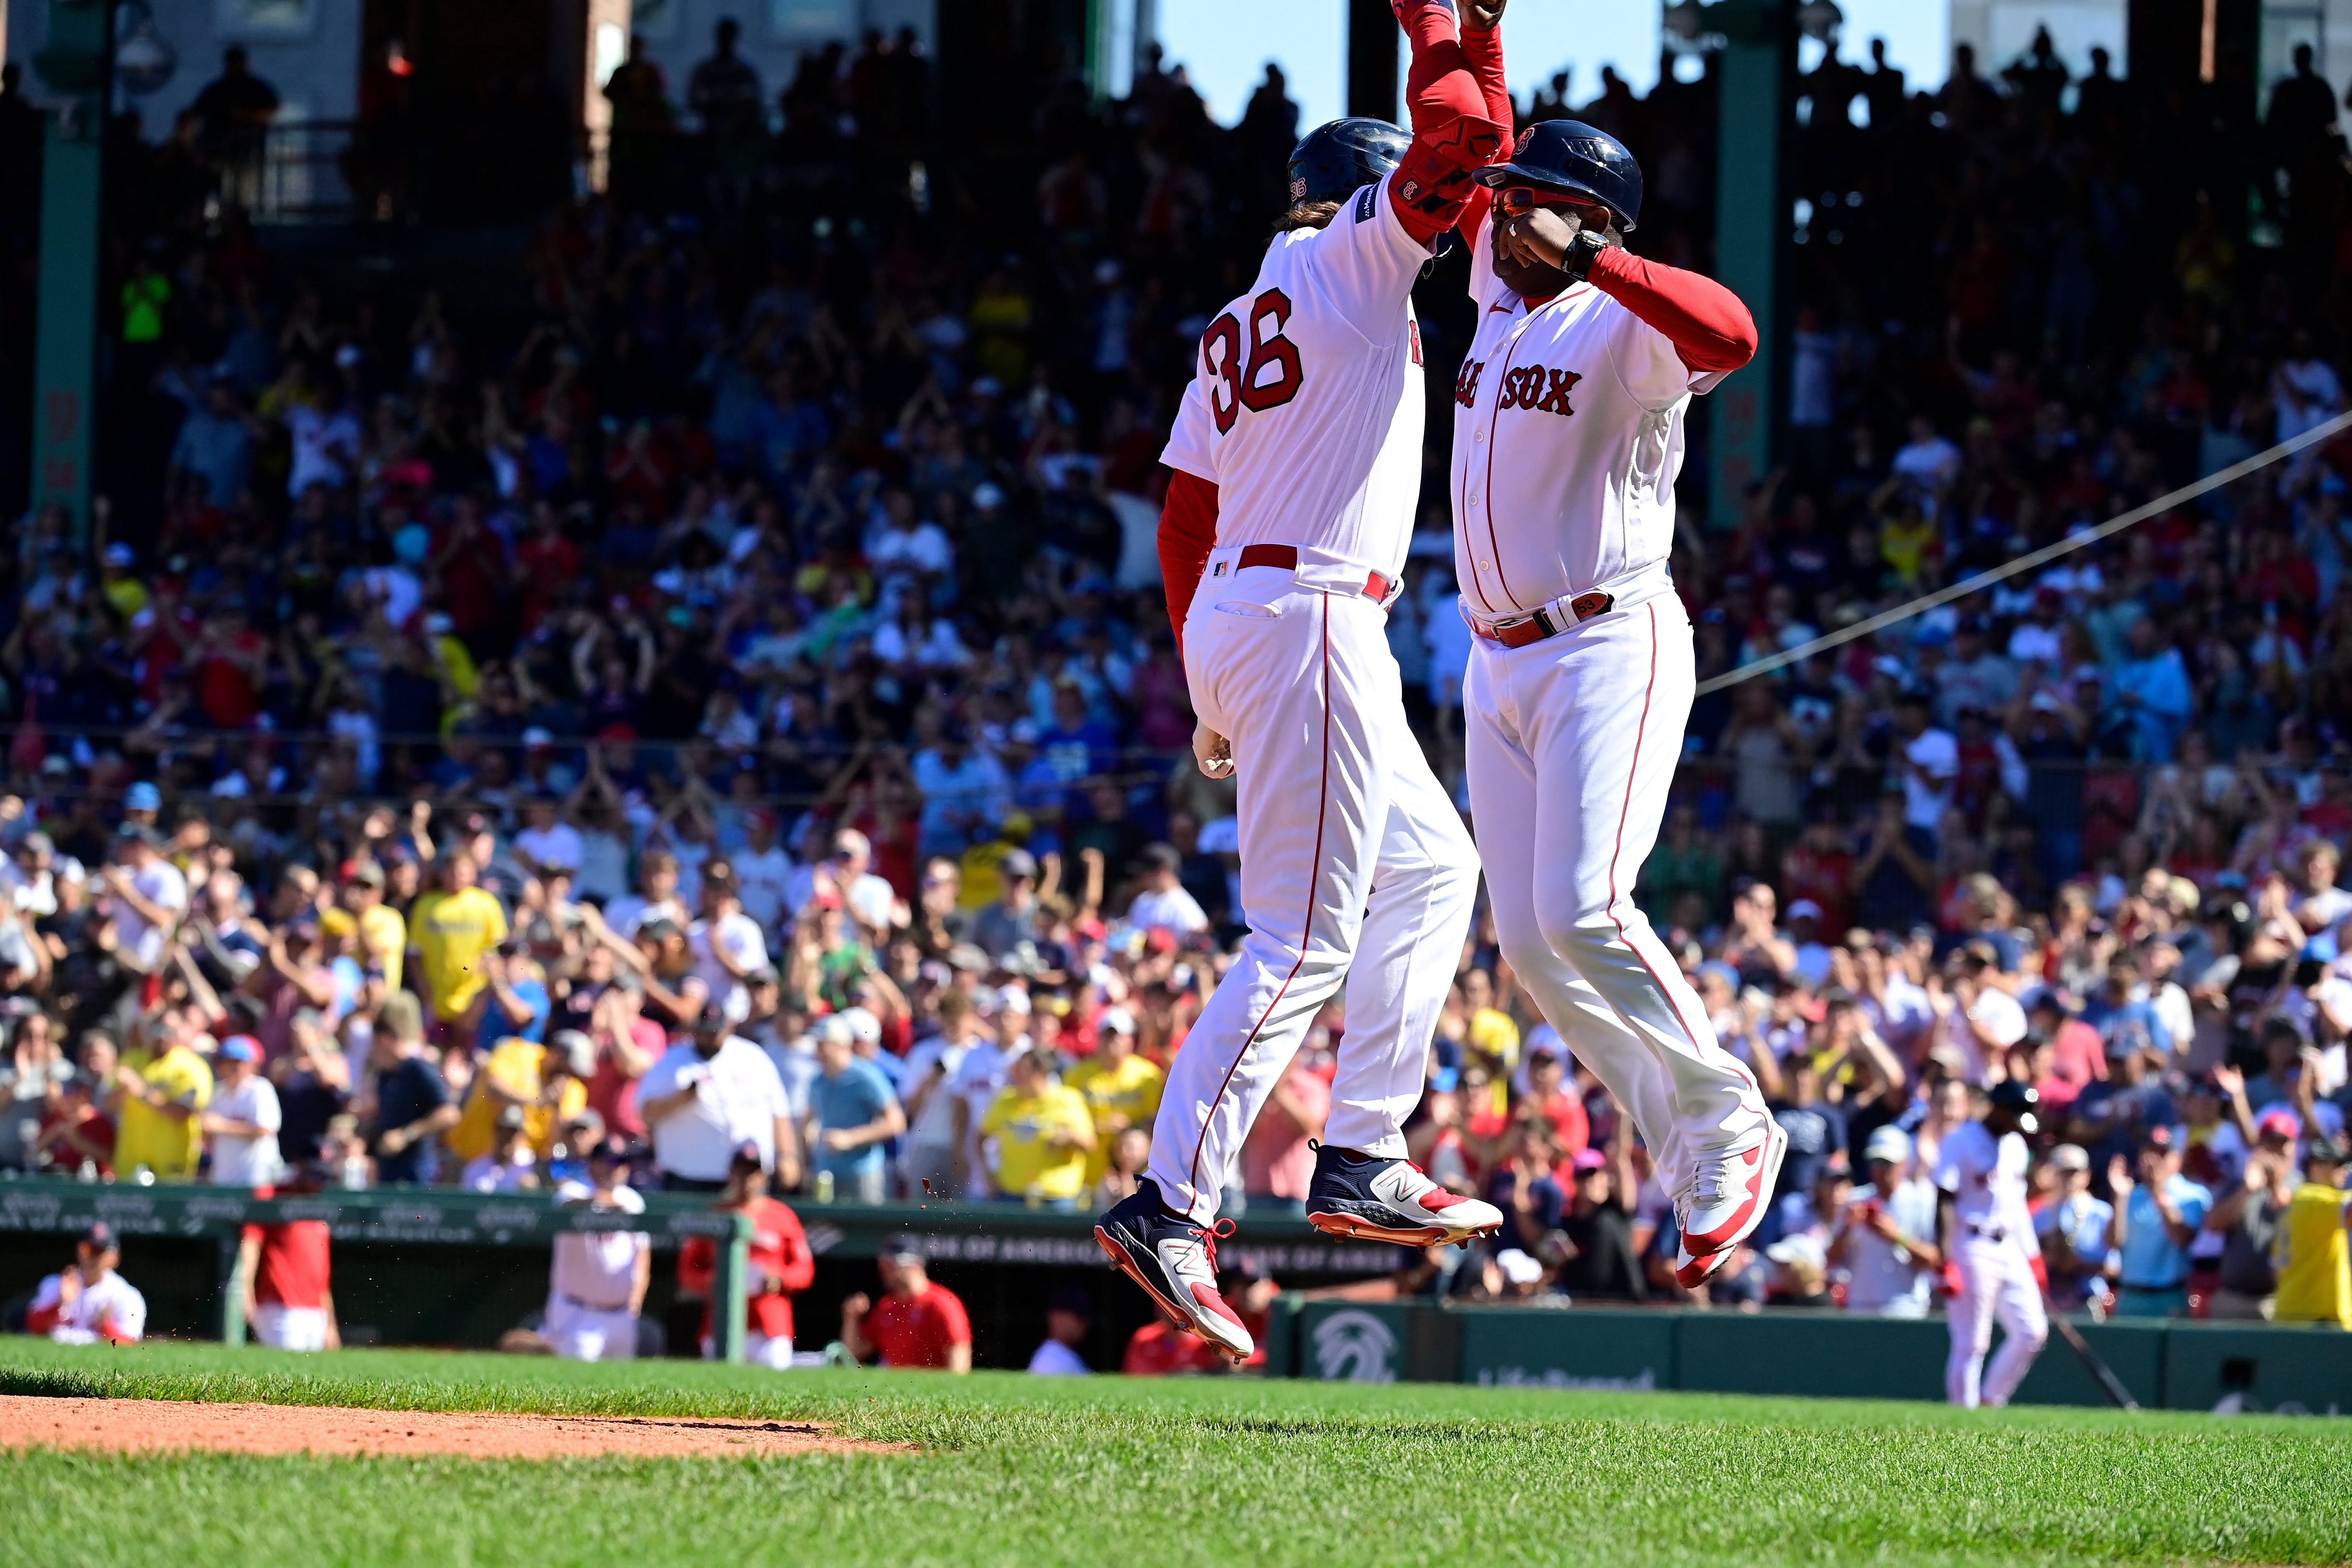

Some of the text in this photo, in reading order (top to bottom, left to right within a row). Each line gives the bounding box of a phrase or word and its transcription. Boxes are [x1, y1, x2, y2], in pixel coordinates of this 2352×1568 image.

[1290, 177, 1307, 202] 36
[1403, 181, 1418, 200] B
[1203, 286, 1304, 437] 36
[1499, 364, 1582, 416] SOX
[1576, 599, 1595, 614] 53
